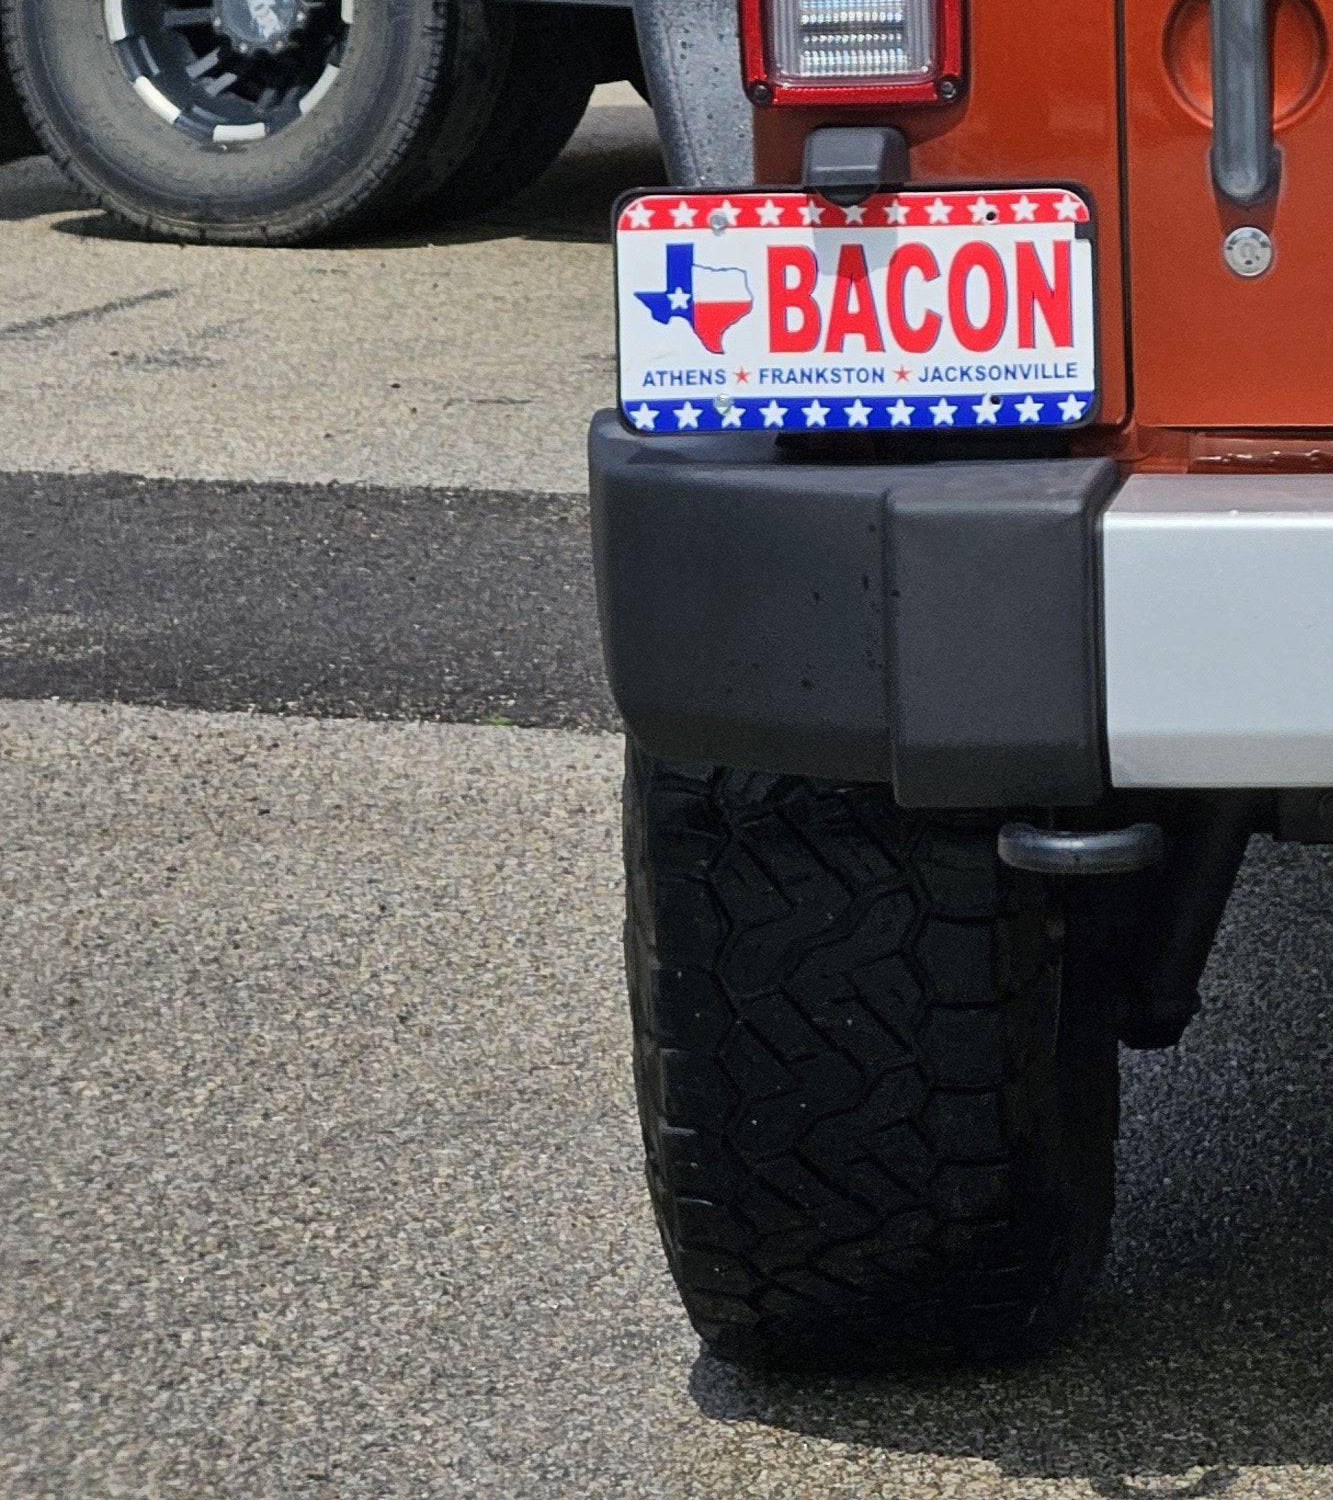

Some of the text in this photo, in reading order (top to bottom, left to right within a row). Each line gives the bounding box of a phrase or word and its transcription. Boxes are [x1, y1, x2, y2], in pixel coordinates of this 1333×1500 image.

[765, 239, 1075, 355] BACON
[641, 361, 1079, 388] ATHENS FRANKSTON JACKSONVILLE
